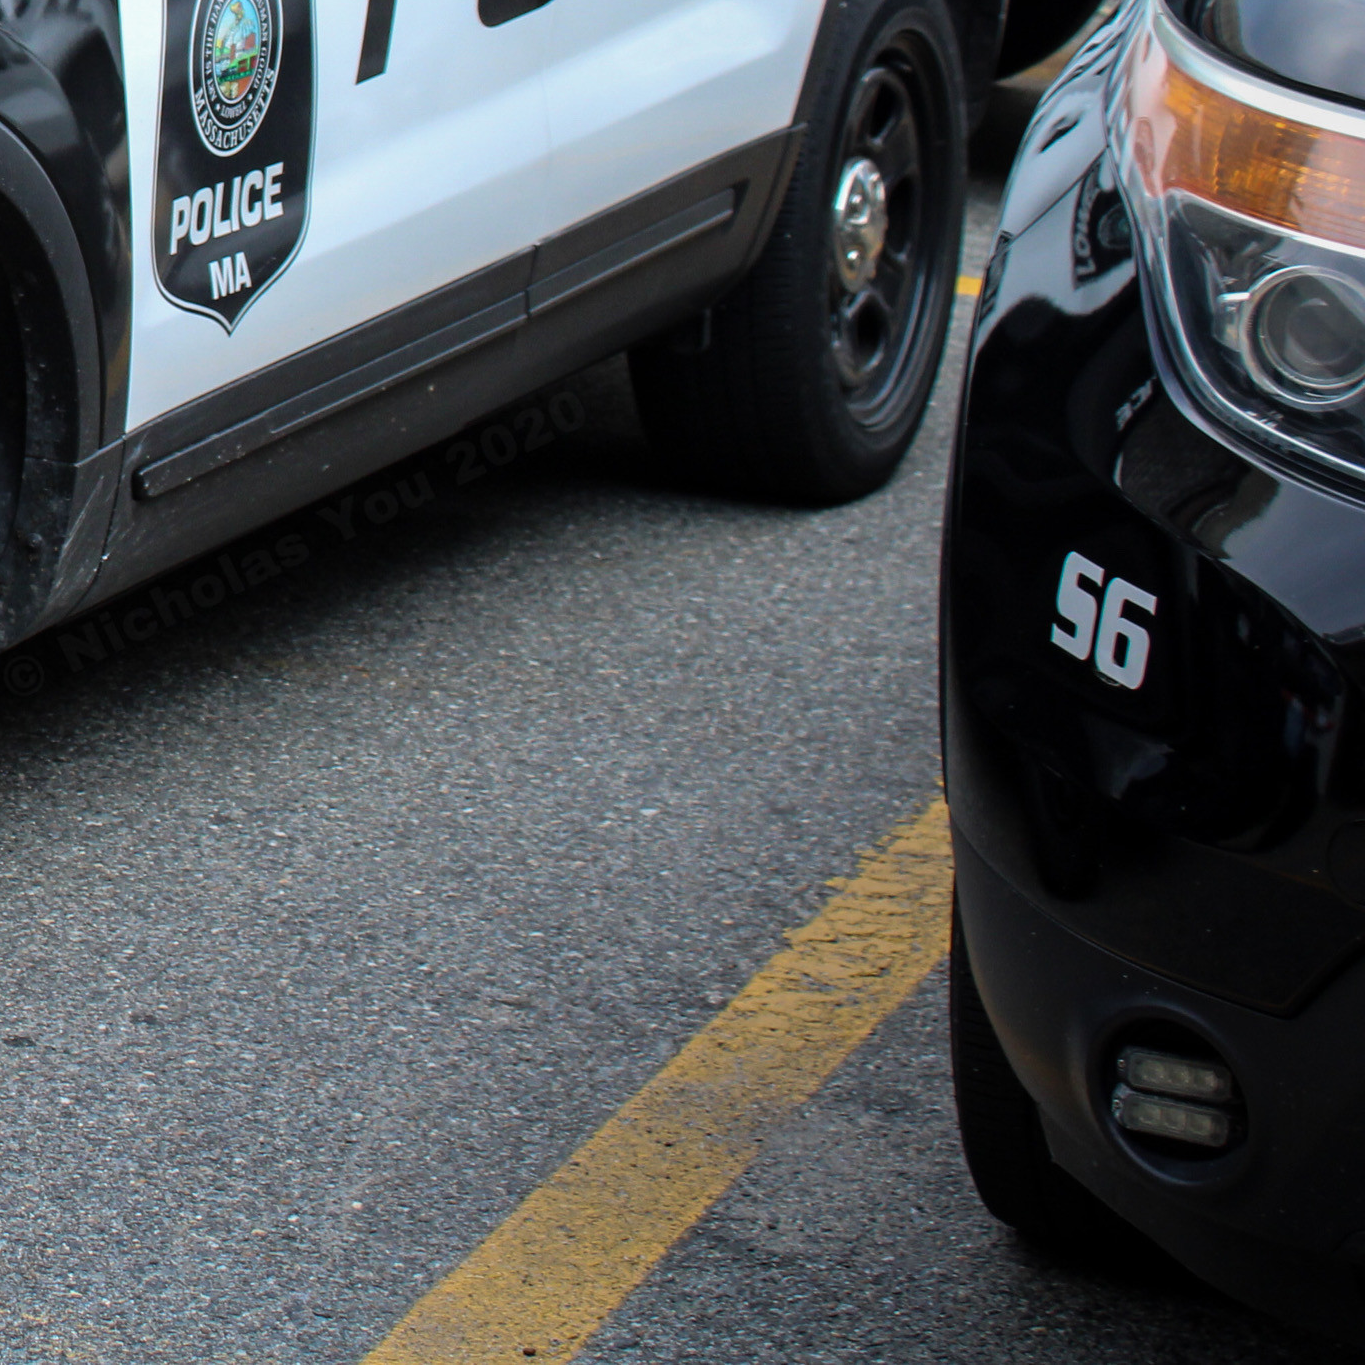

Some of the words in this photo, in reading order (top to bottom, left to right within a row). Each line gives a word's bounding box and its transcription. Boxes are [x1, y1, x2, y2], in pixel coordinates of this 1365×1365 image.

[194, 68, 275, 150] MASSACHUSETTS
[170, 161, 284, 255] POLICE
[208, 251, 253, 300] MA
[1050, 550, 1158, 690] S6
